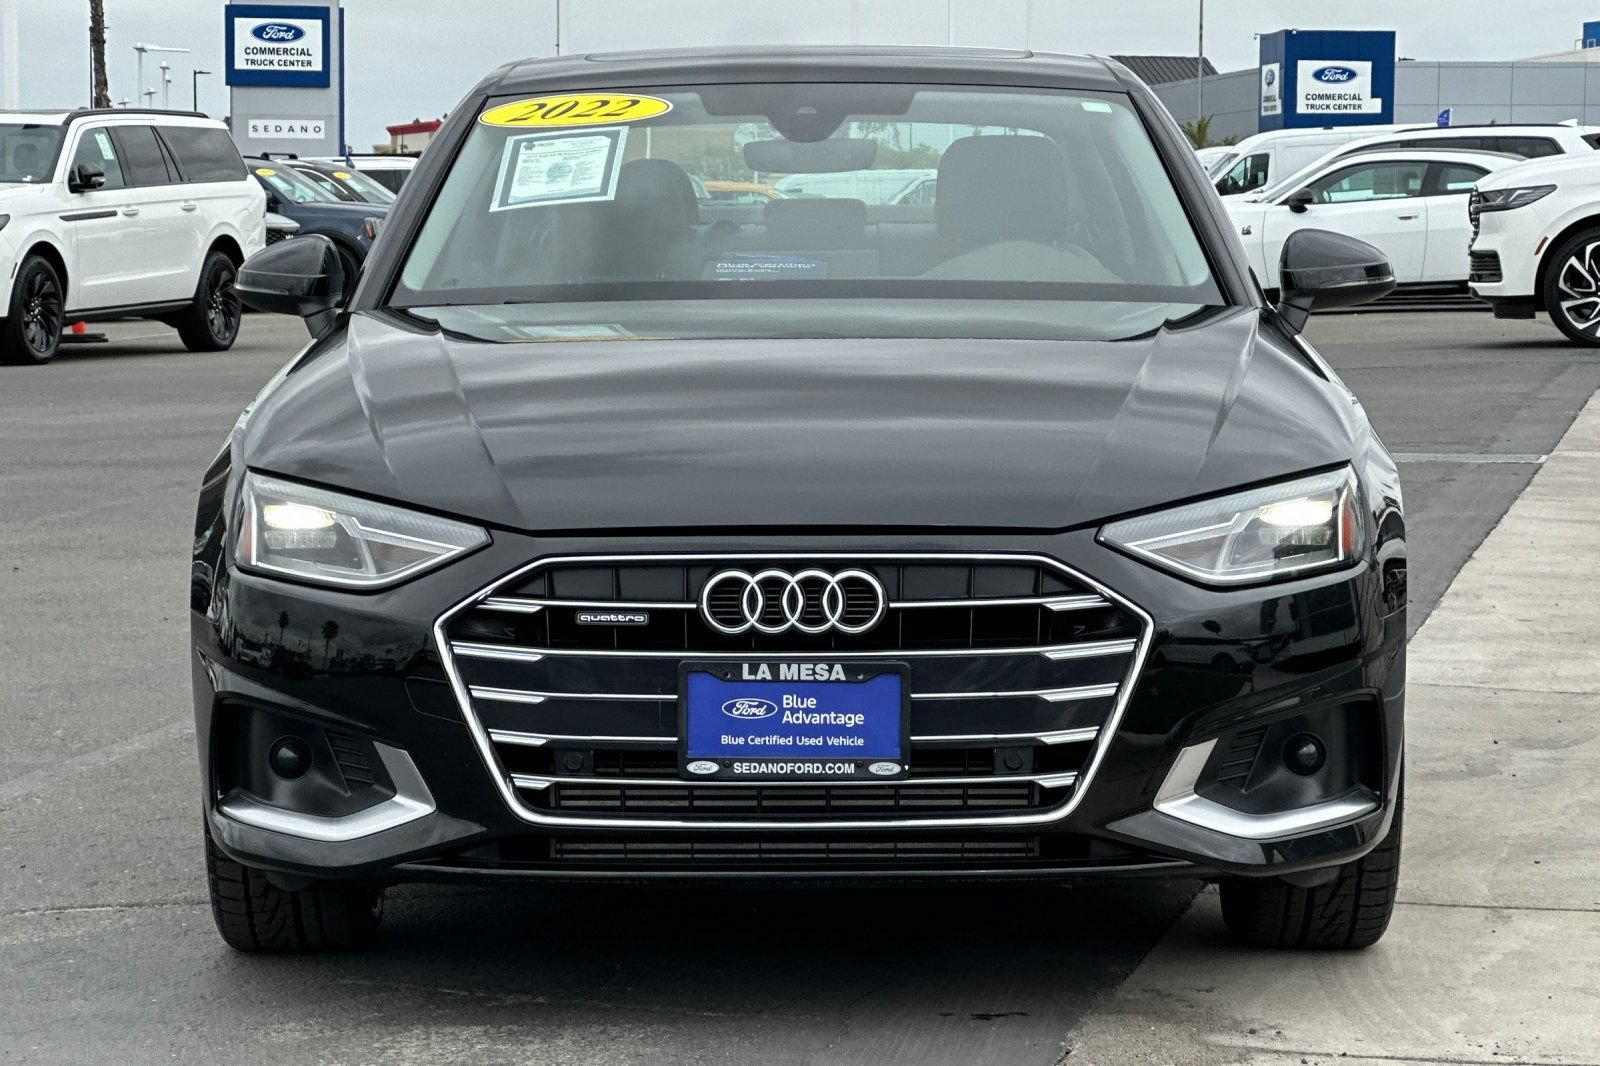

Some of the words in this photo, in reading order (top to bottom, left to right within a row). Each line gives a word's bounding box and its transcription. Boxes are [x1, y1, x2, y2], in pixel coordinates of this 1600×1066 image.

[262, 25, 294, 39] Ford
[244, 46, 312, 57] COMMERCIAL
[245, 58, 275, 67] TRUCK
[277, 59, 312, 68] CENTER
[1321, 69, 1349, 80] Ford
[1305, 93, 1362, 101] COMMERCIAL
[505, 99, 641, 123] 2022
[1305, 103, 1331, 111] TRUCK
[1333, 103, 1362, 111] CENTER
[251, 125, 322, 134] SEDANO
[580, 614, 645, 622] quattro
[742, 663, 772, 680] LA
[779, 664, 846, 681] MESA
[782, 695, 817, 709] Blue
[732, 700, 767, 717] Ford
[782, 711, 865, 727] Advantage
[721, 735, 745, 745] Blue
[748, 735, 793, 746] Certified
[796, 736, 823, 746] Used
[827, 736, 864, 746] Vehicle
[693, 763, 712, 773] Ford
[733, 762, 855, 774] SEDANOFORD.COM
[875, 764, 895, 774] Ford
